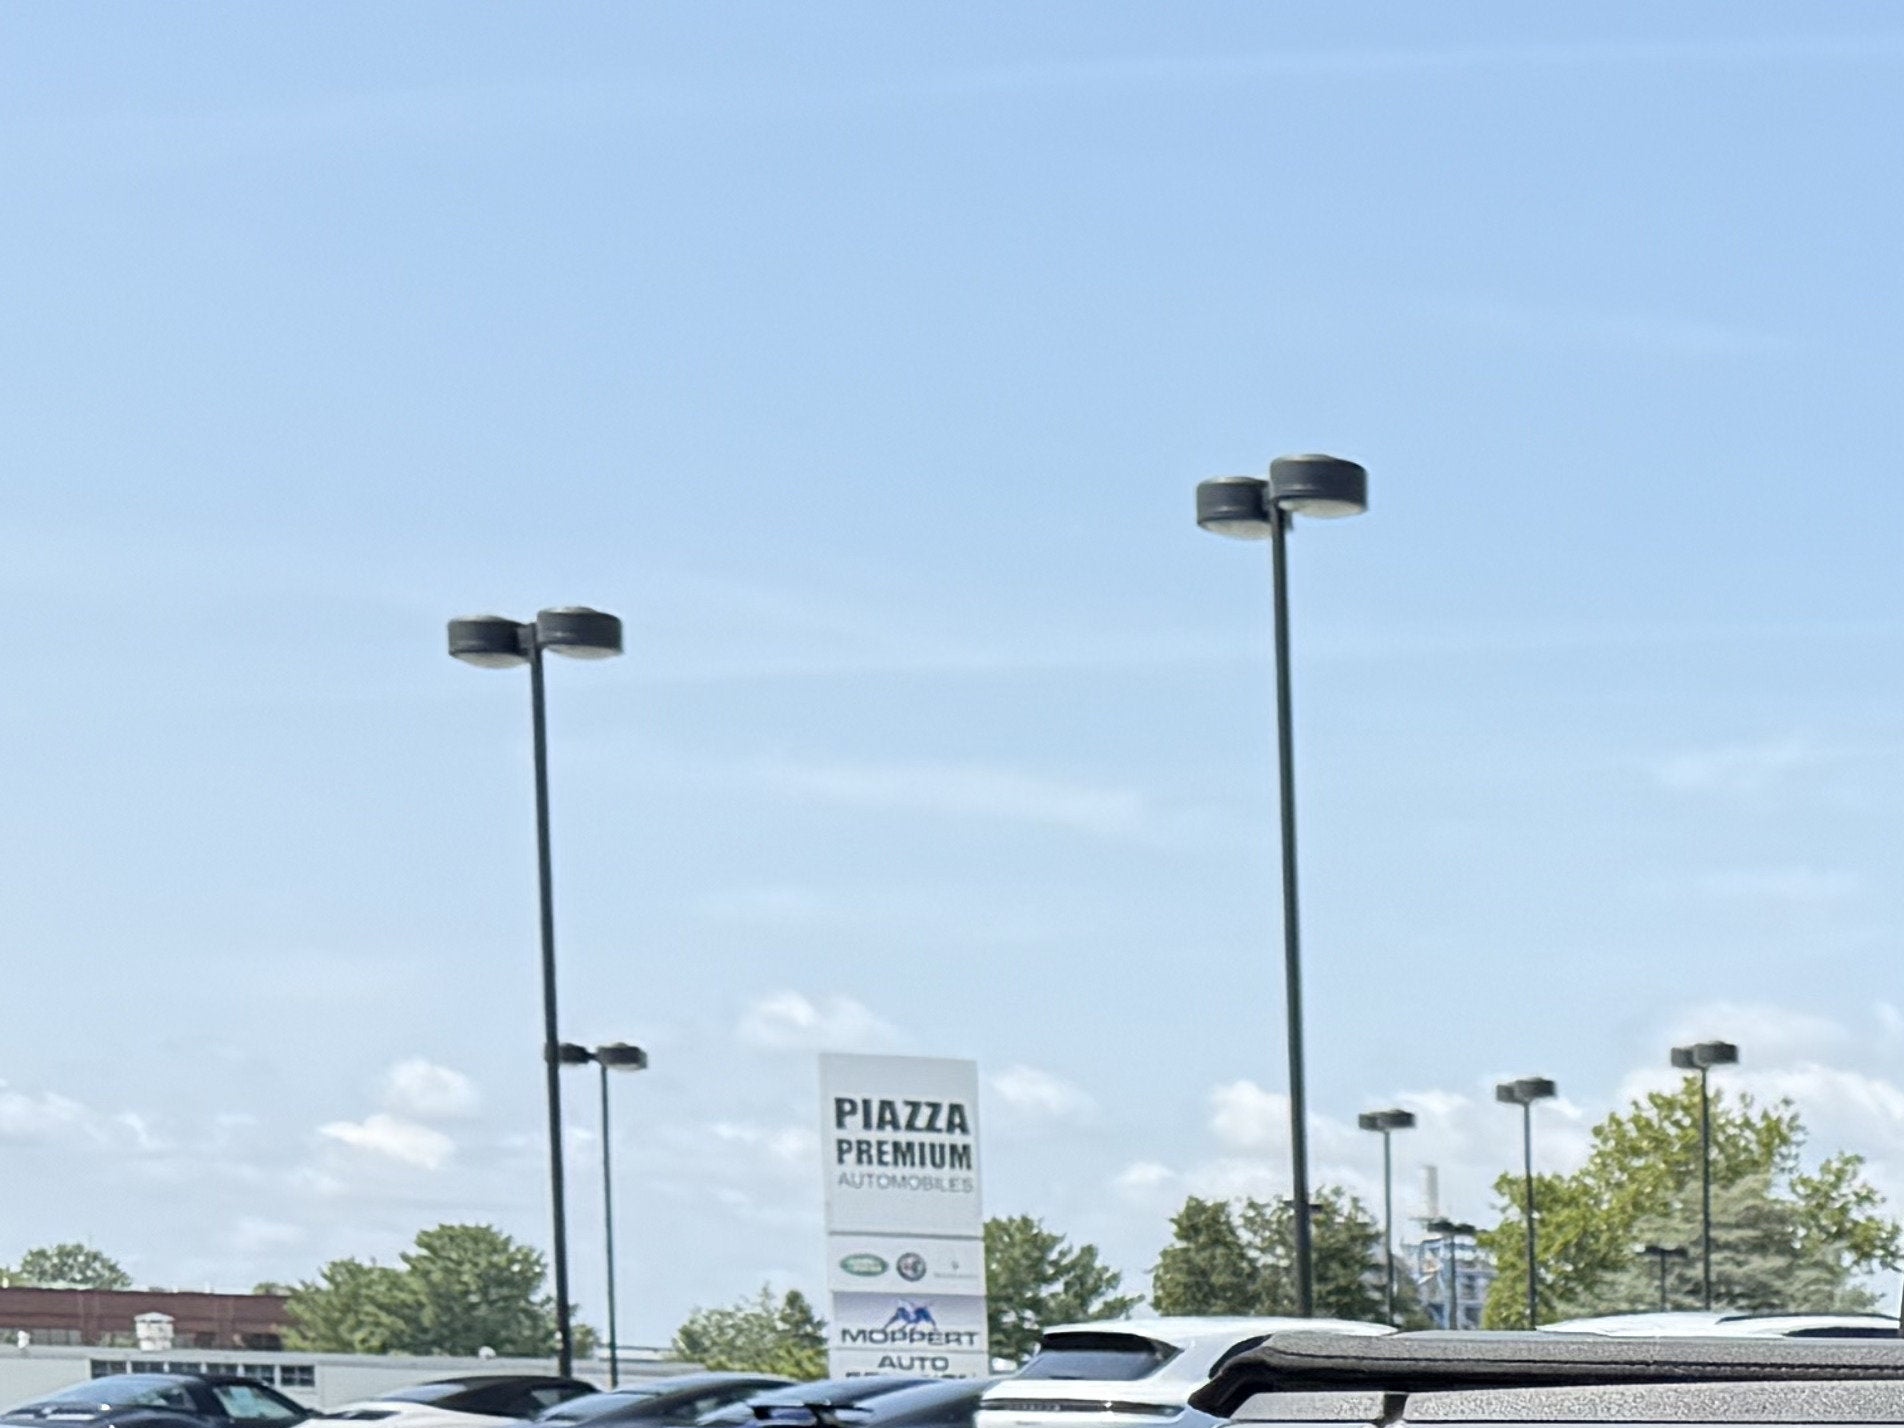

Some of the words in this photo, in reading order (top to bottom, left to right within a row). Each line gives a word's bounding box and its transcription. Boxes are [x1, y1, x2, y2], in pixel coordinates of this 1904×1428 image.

[834, 1097, 970, 1135] PIAZZA
[836, 1138, 972, 1170] PREMIUM
[838, 1172, 974, 1194] AUTOMOBILES
[840, 1328, 979, 1346] MOPPERT
[878, 1355, 949, 1372] AUTO
